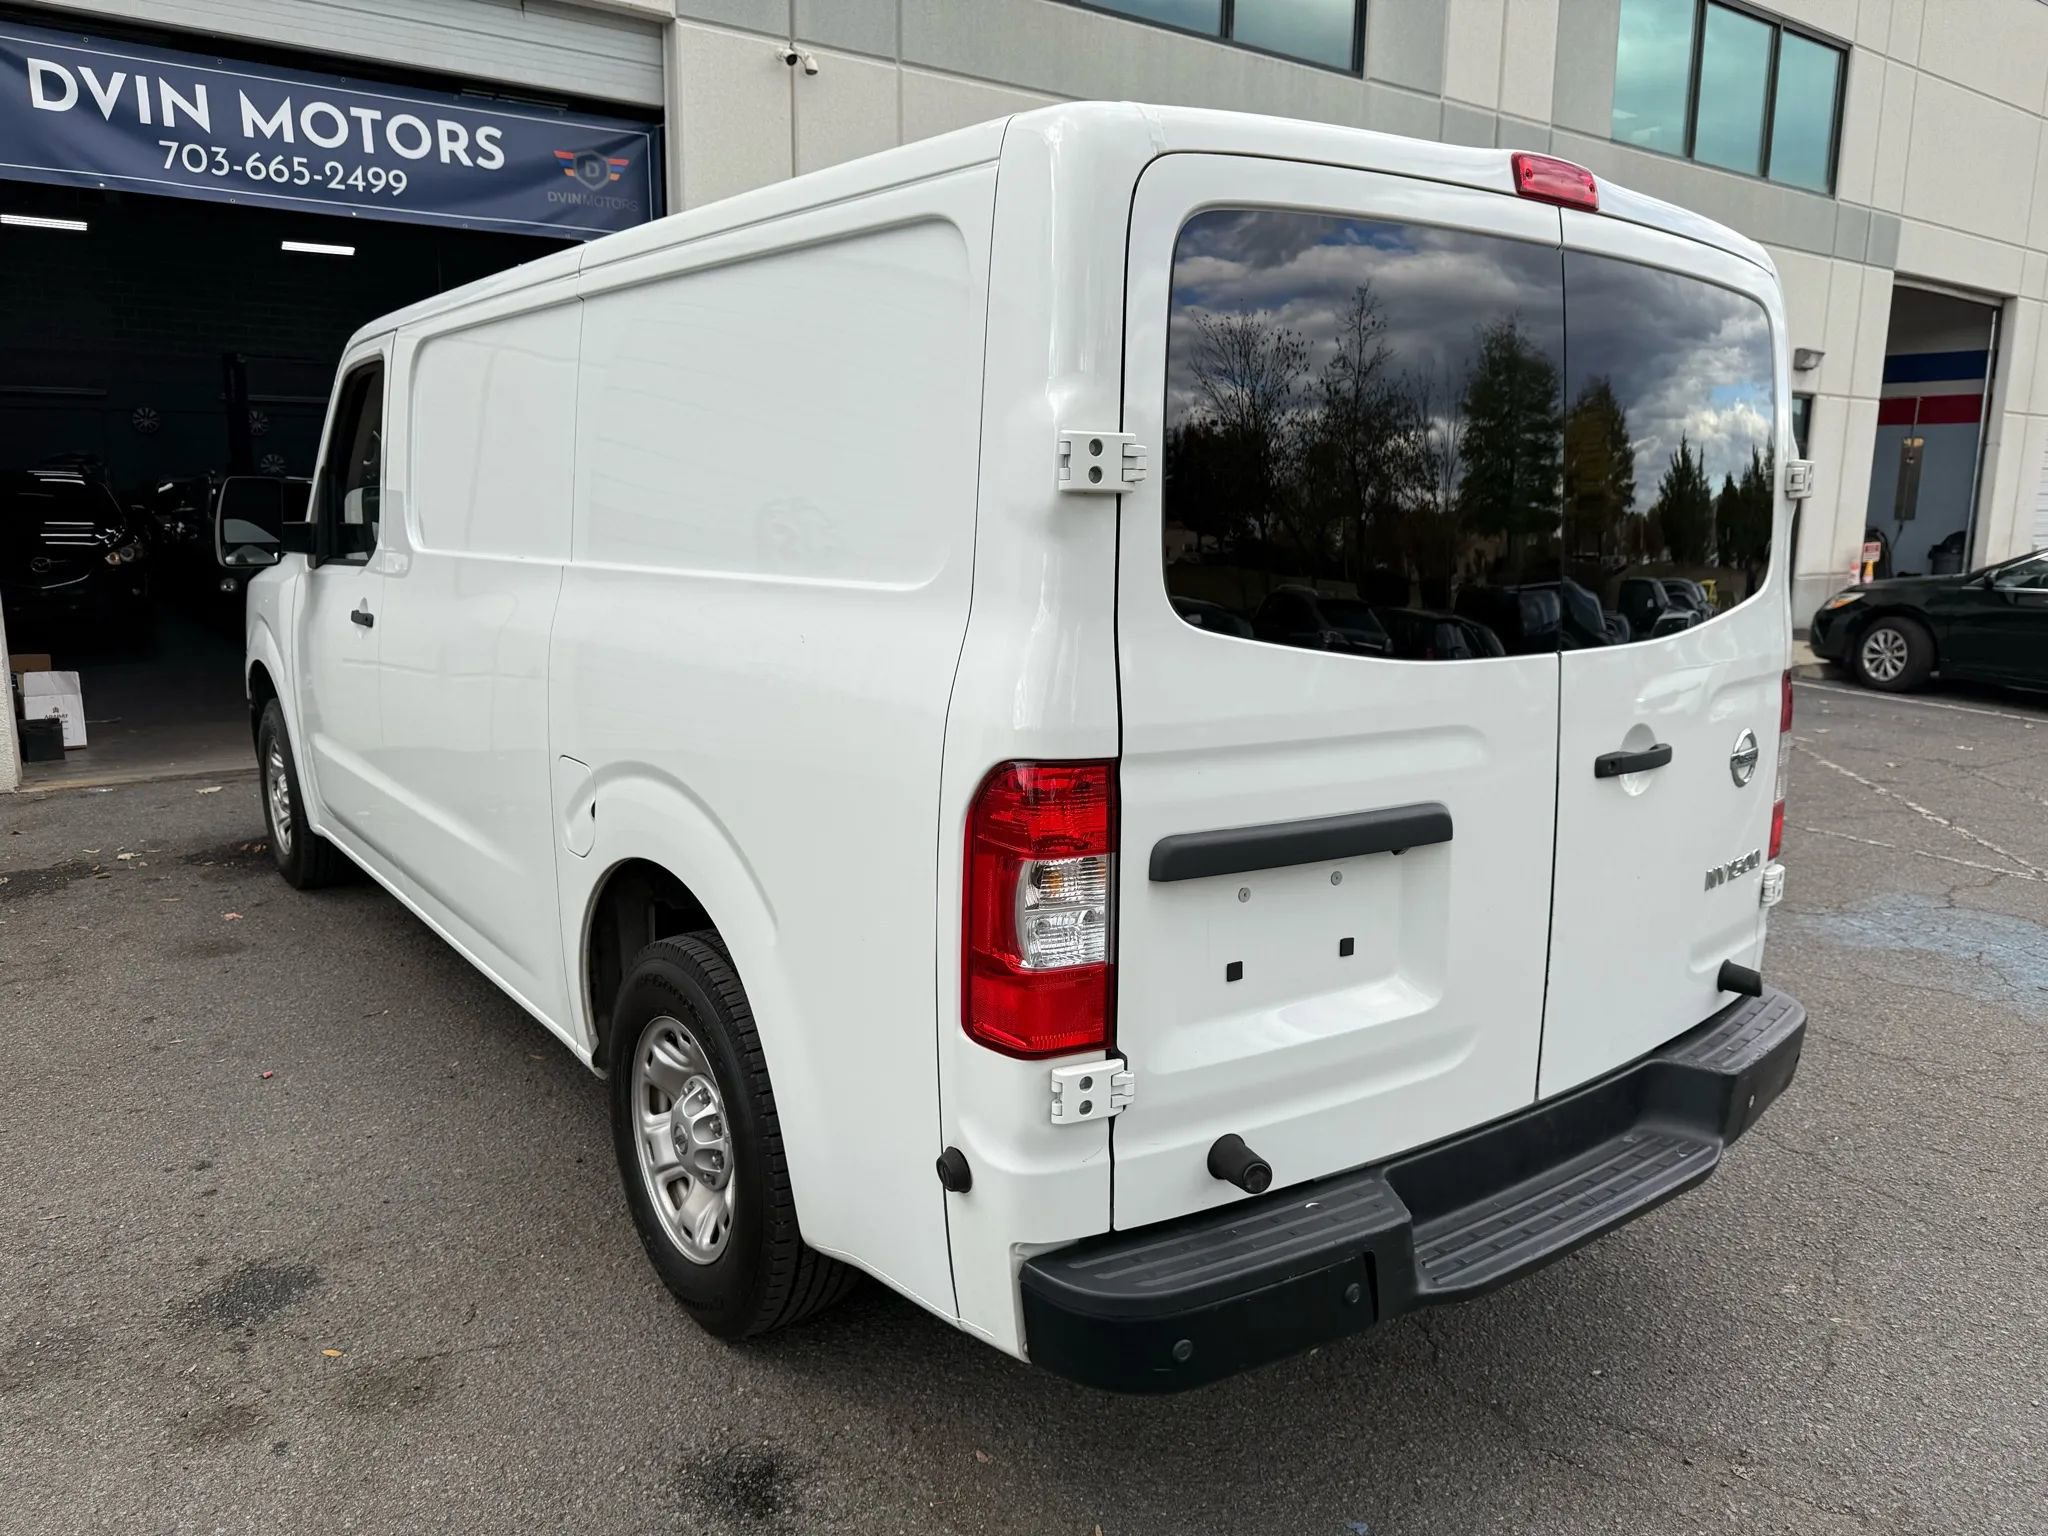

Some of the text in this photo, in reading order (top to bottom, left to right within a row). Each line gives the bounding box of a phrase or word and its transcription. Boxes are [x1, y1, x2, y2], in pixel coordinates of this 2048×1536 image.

[26, 57, 505, 171] DVIN MOTORS
[158, 140, 408, 197] 703-665-2499
